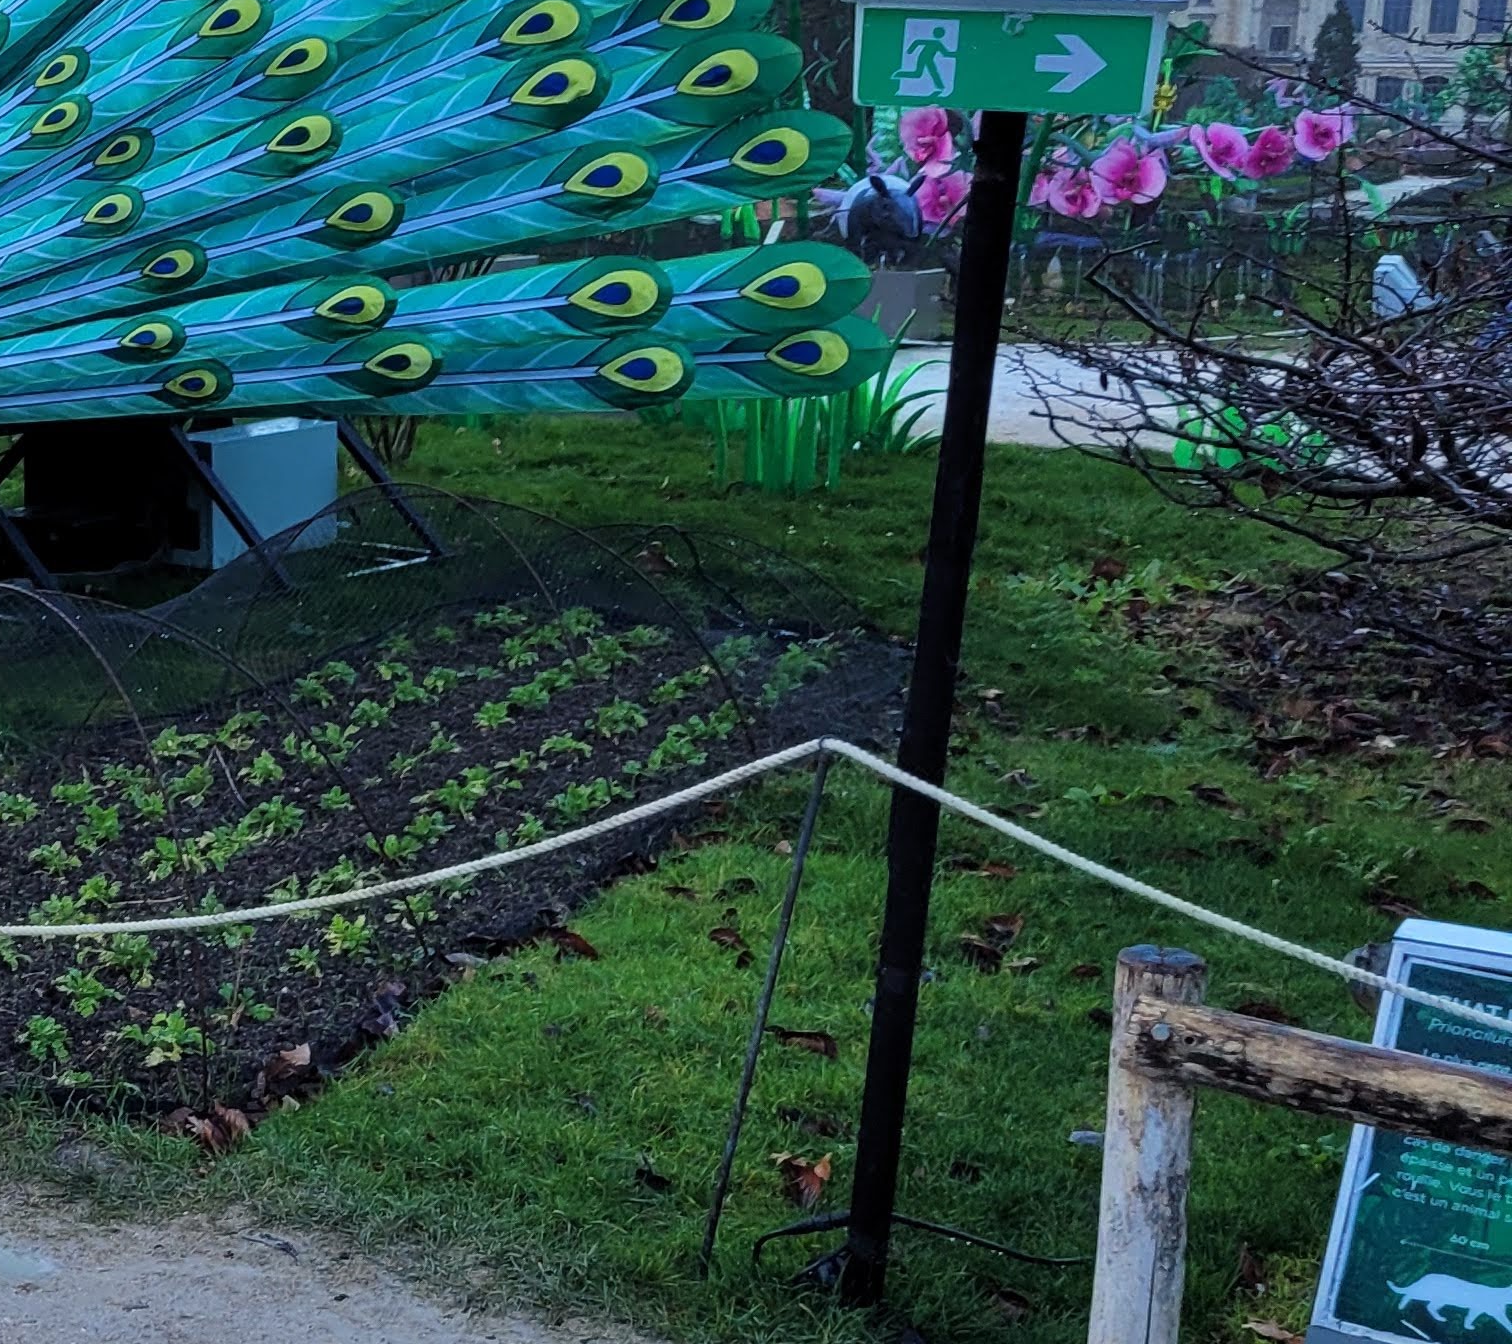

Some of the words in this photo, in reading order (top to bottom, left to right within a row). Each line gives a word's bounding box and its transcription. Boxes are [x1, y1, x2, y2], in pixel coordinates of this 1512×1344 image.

[1457, 1166, 1472, 1178] et
[1477, 1170, 1495, 1181] un
[1449, 1180, 1484, 1198] Vous
[1429, 1197, 1448, 1209] un
[1450, 1202, 1501, 1219] animal
